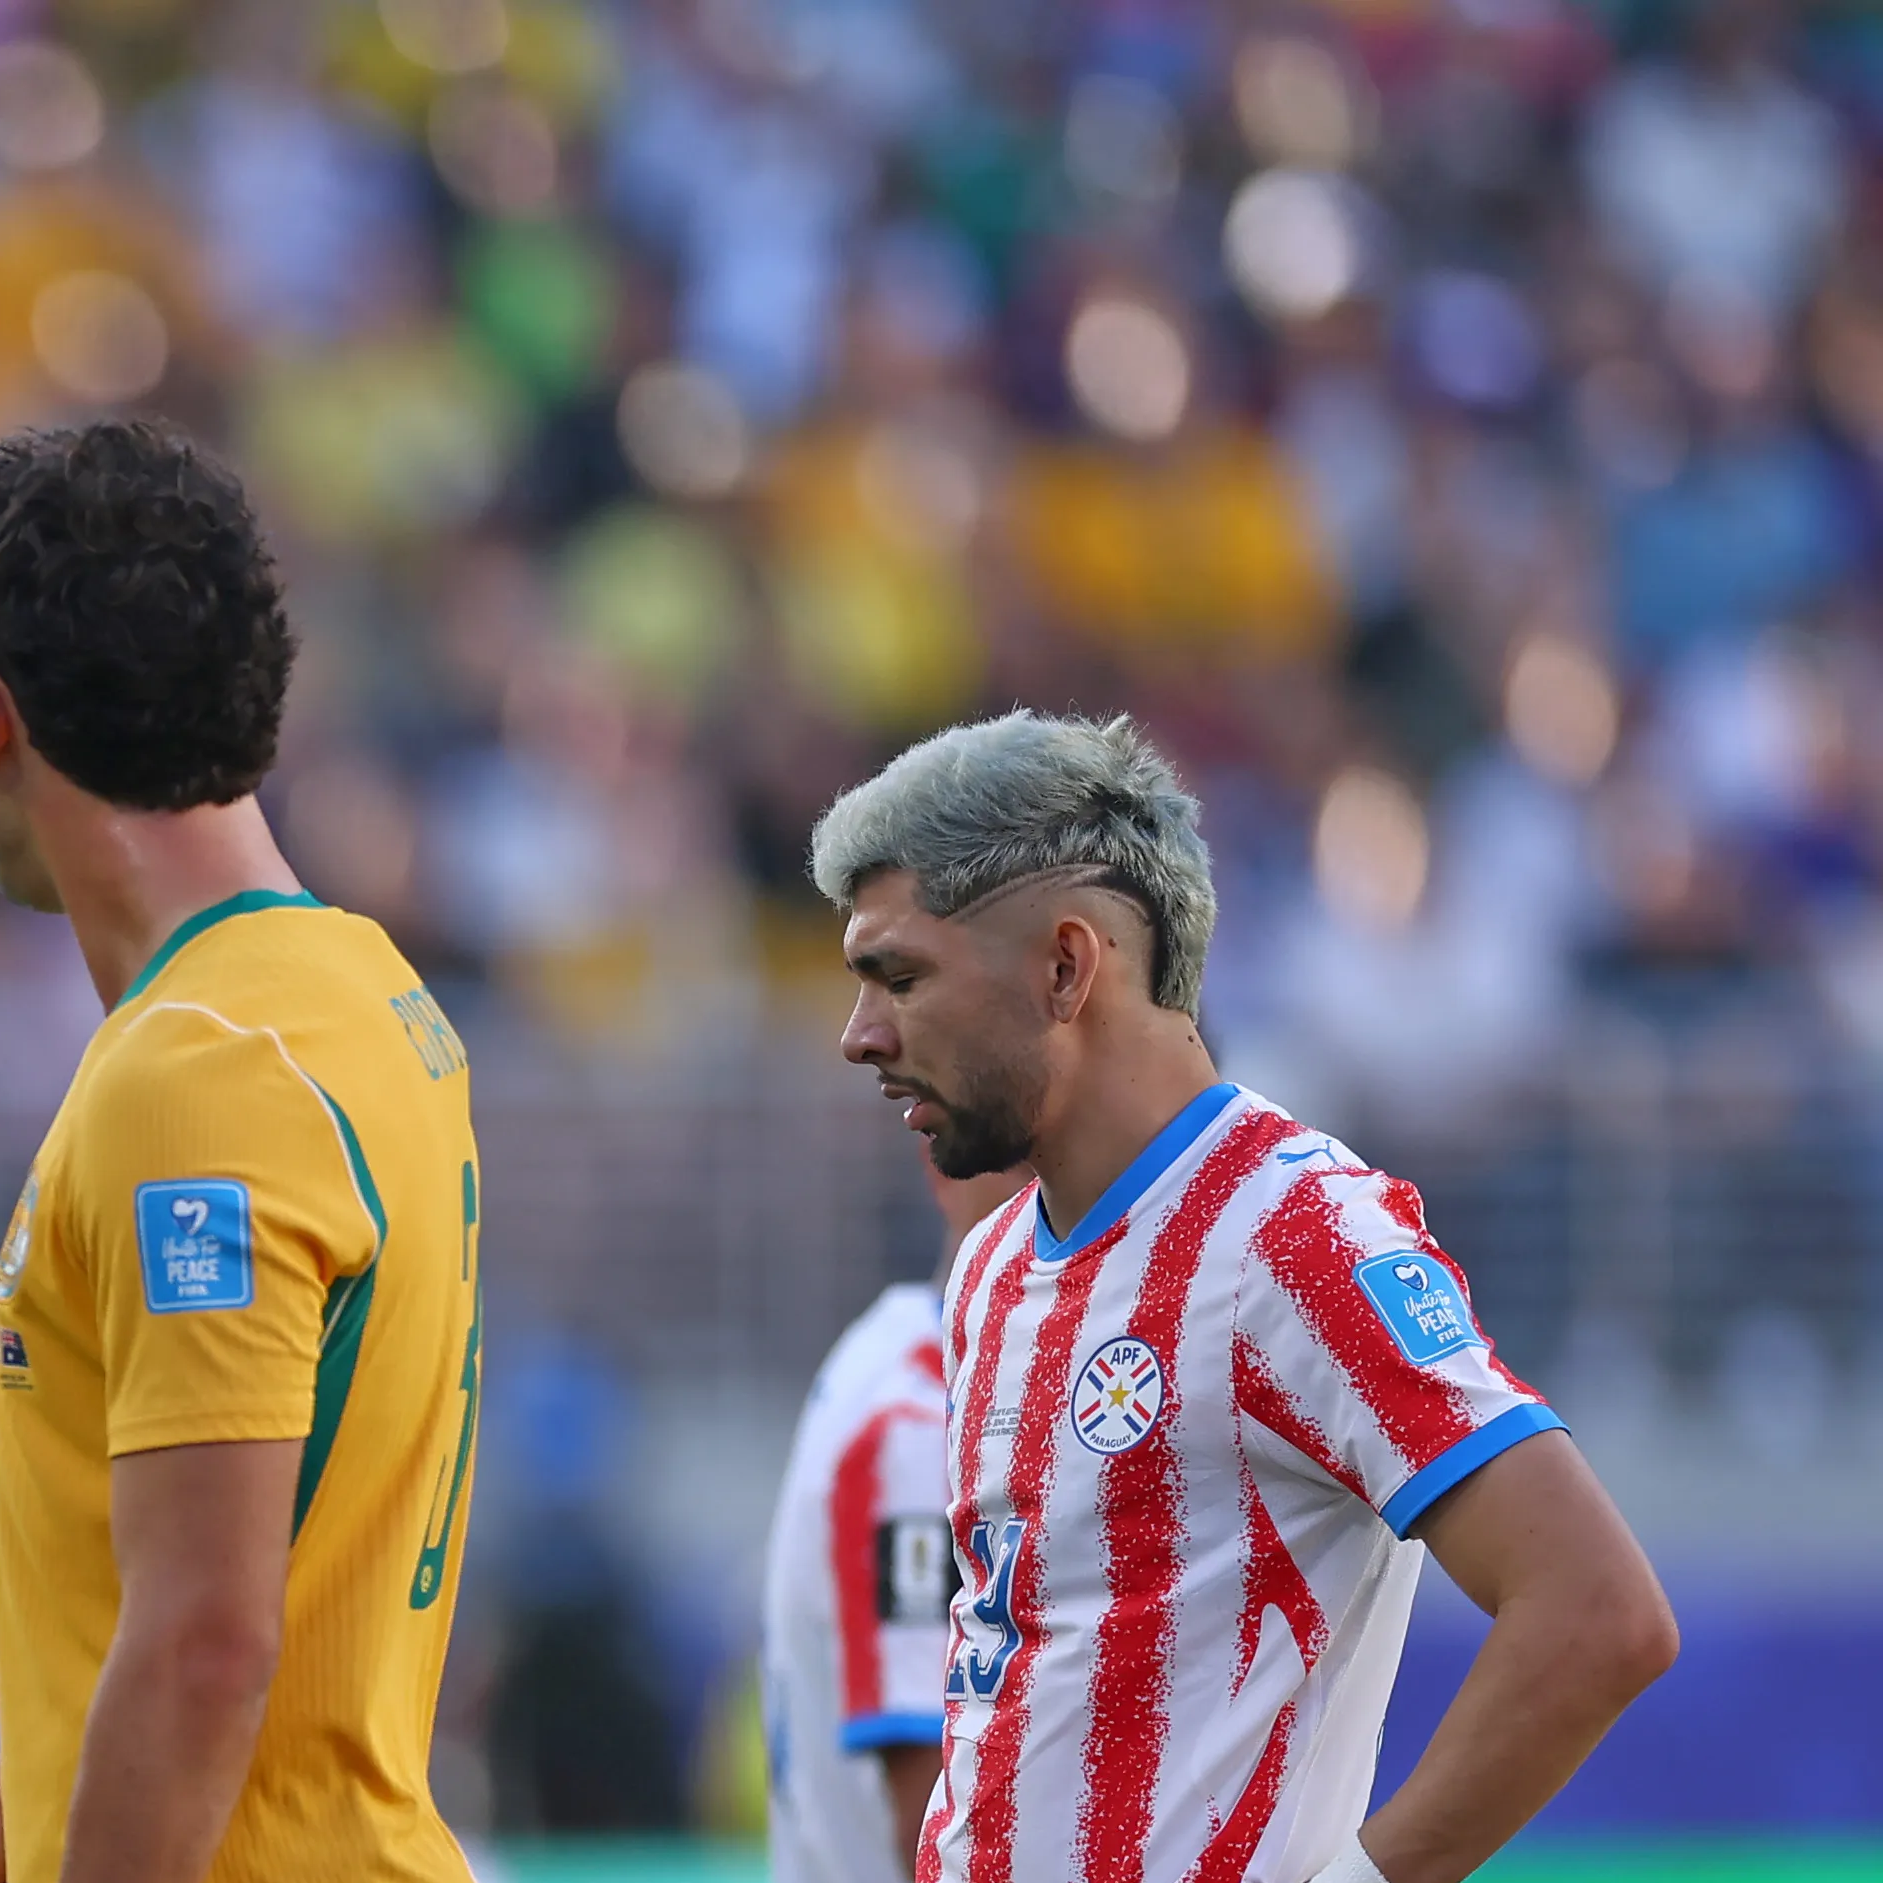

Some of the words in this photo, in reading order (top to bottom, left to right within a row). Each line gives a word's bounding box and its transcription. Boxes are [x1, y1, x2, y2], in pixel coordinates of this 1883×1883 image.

[1437, 1326, 1464, 1344] FIFA
[1109, 1347, 1141, 1365] APF
[1089, 1433, 1132, 1448] PARAGUAY
